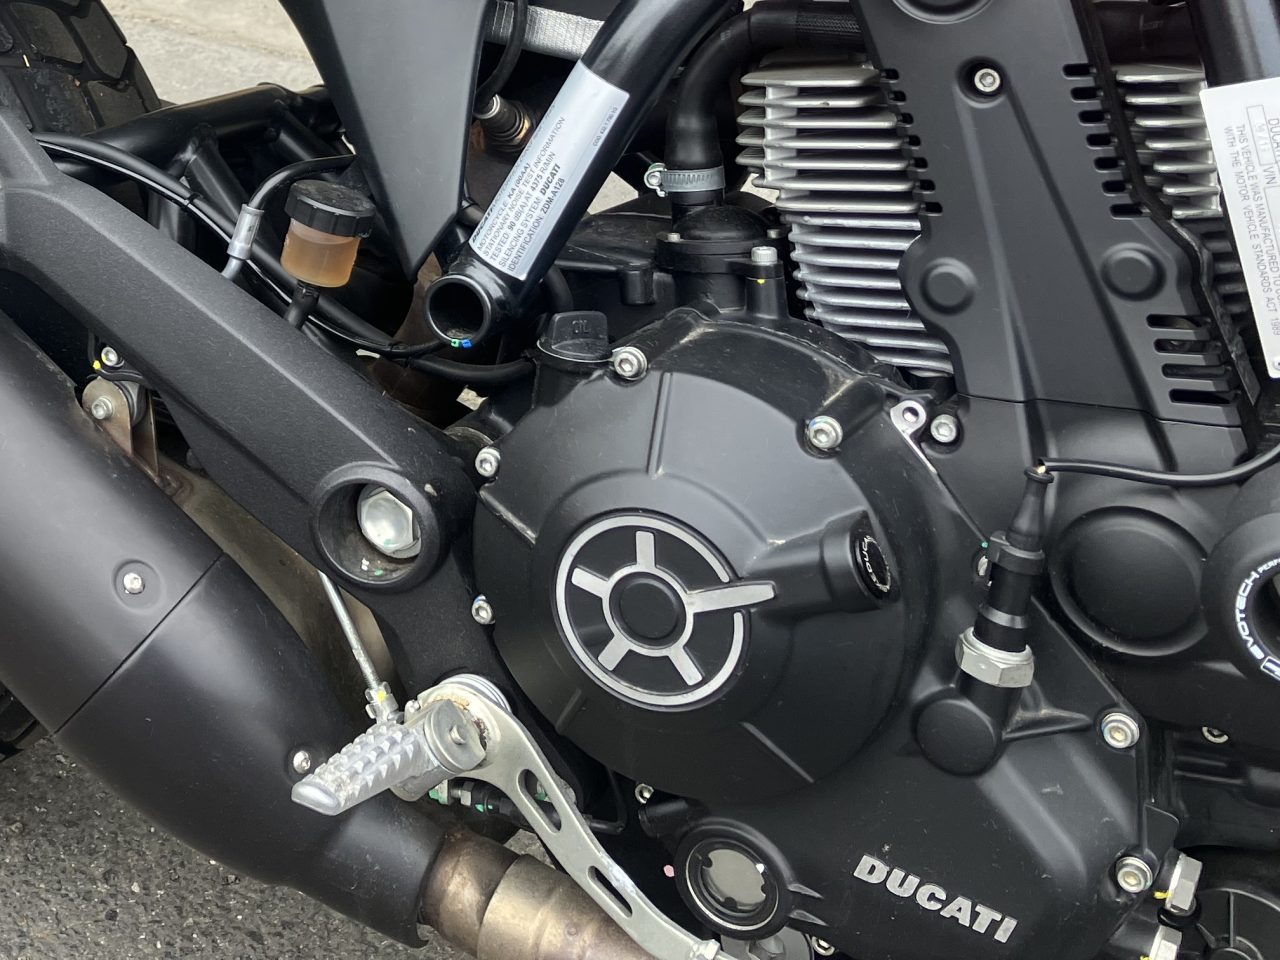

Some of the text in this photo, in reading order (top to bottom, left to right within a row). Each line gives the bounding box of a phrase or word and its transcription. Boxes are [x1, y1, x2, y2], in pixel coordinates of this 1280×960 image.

[1222, 125, 1237, 149] WITH
[1235, 122, 1249, 145] THIS
[1229, 150, 1242, 168] THE
[1239, 143, 1258, 182] VEHICLE
[1261, 165, 1277, 186] VIN
[480, 211, 511, 257] STATIONARY
[506, 187, 525, 212] NOISE
[520, 167, 536, 188] TEST
[531, 115, 566, 169] INFORMATION
[505, 219, 516, 231] 90
[528, 172, 544, 192] 4375
[1233, 169, 1250, 202] MOTOR
[1248, 181, 1263, 202] WAS
[496, 226, 525, 268] SILENCING
[538, 162, 562, 196] DUCATI
[1242, 203, 1260, 241] VEHICLE
[1254, 201, 1279, 274] MANUFACTURED
[1251, 242, 1273, 295] STANDARDS
[1263, 295, 1277, 314] ACT
[1235, 570, 1265, 660] EVOTECH
[853, 853, 1019, 945] DUCATI
